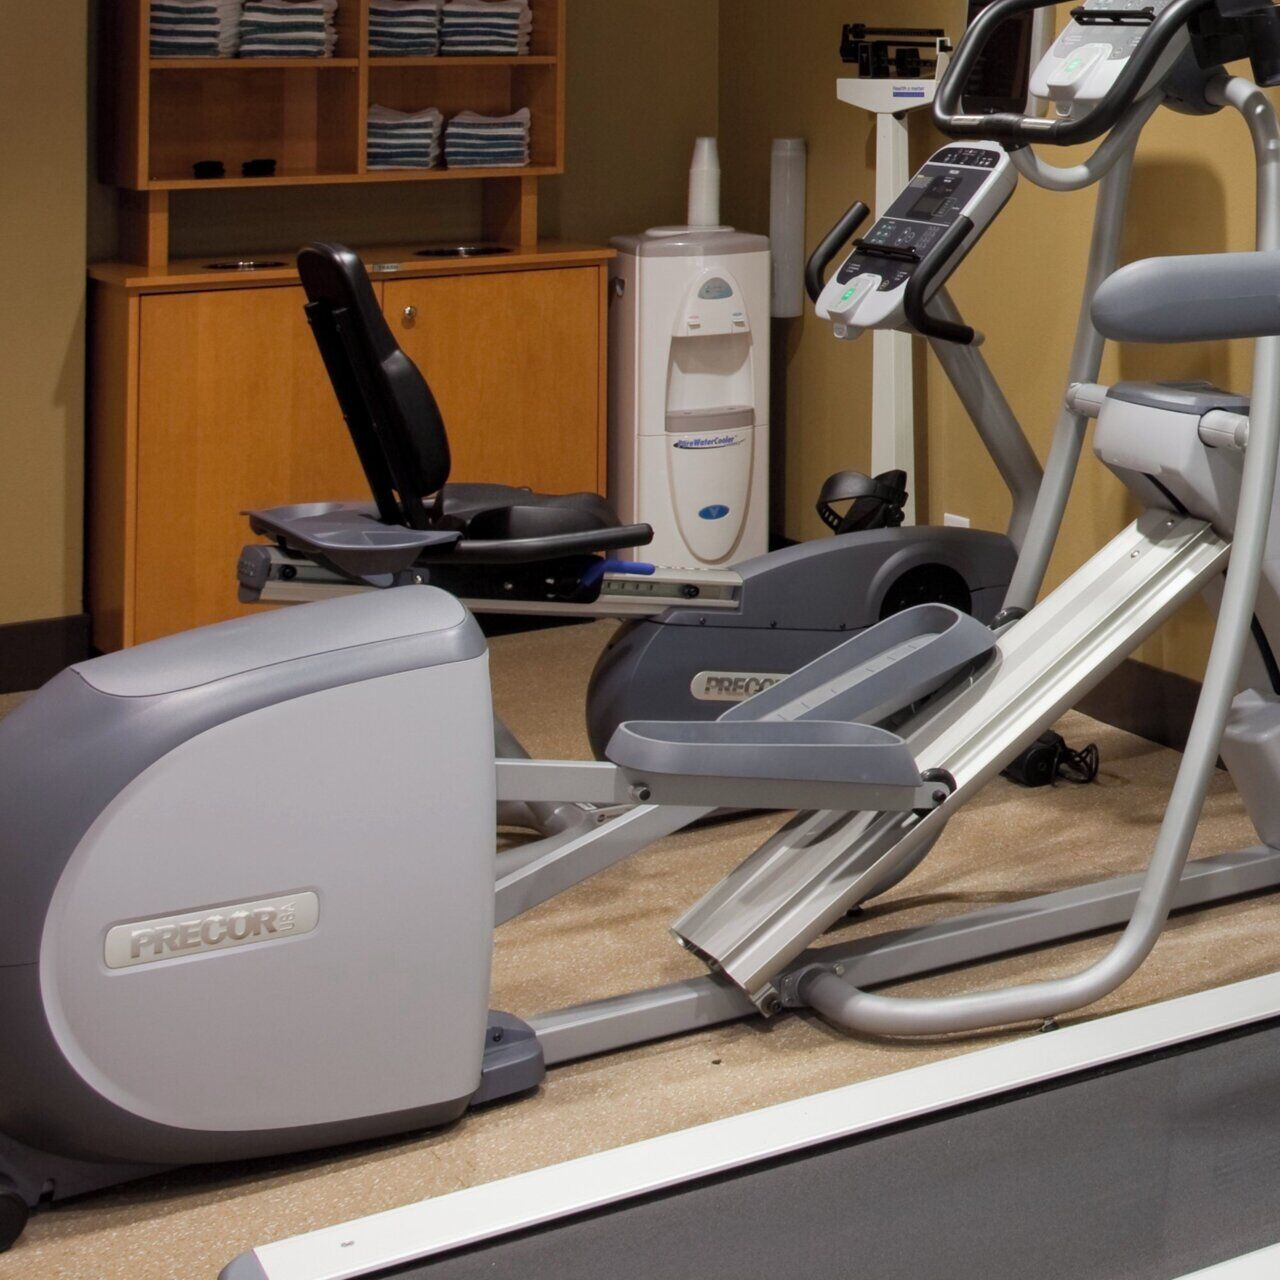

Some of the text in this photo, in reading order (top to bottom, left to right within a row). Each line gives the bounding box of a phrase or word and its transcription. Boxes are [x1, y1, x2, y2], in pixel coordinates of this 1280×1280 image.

[704, 676, 784, 695] PRECO
[130, 900, 298, 959] PRECOR USA
